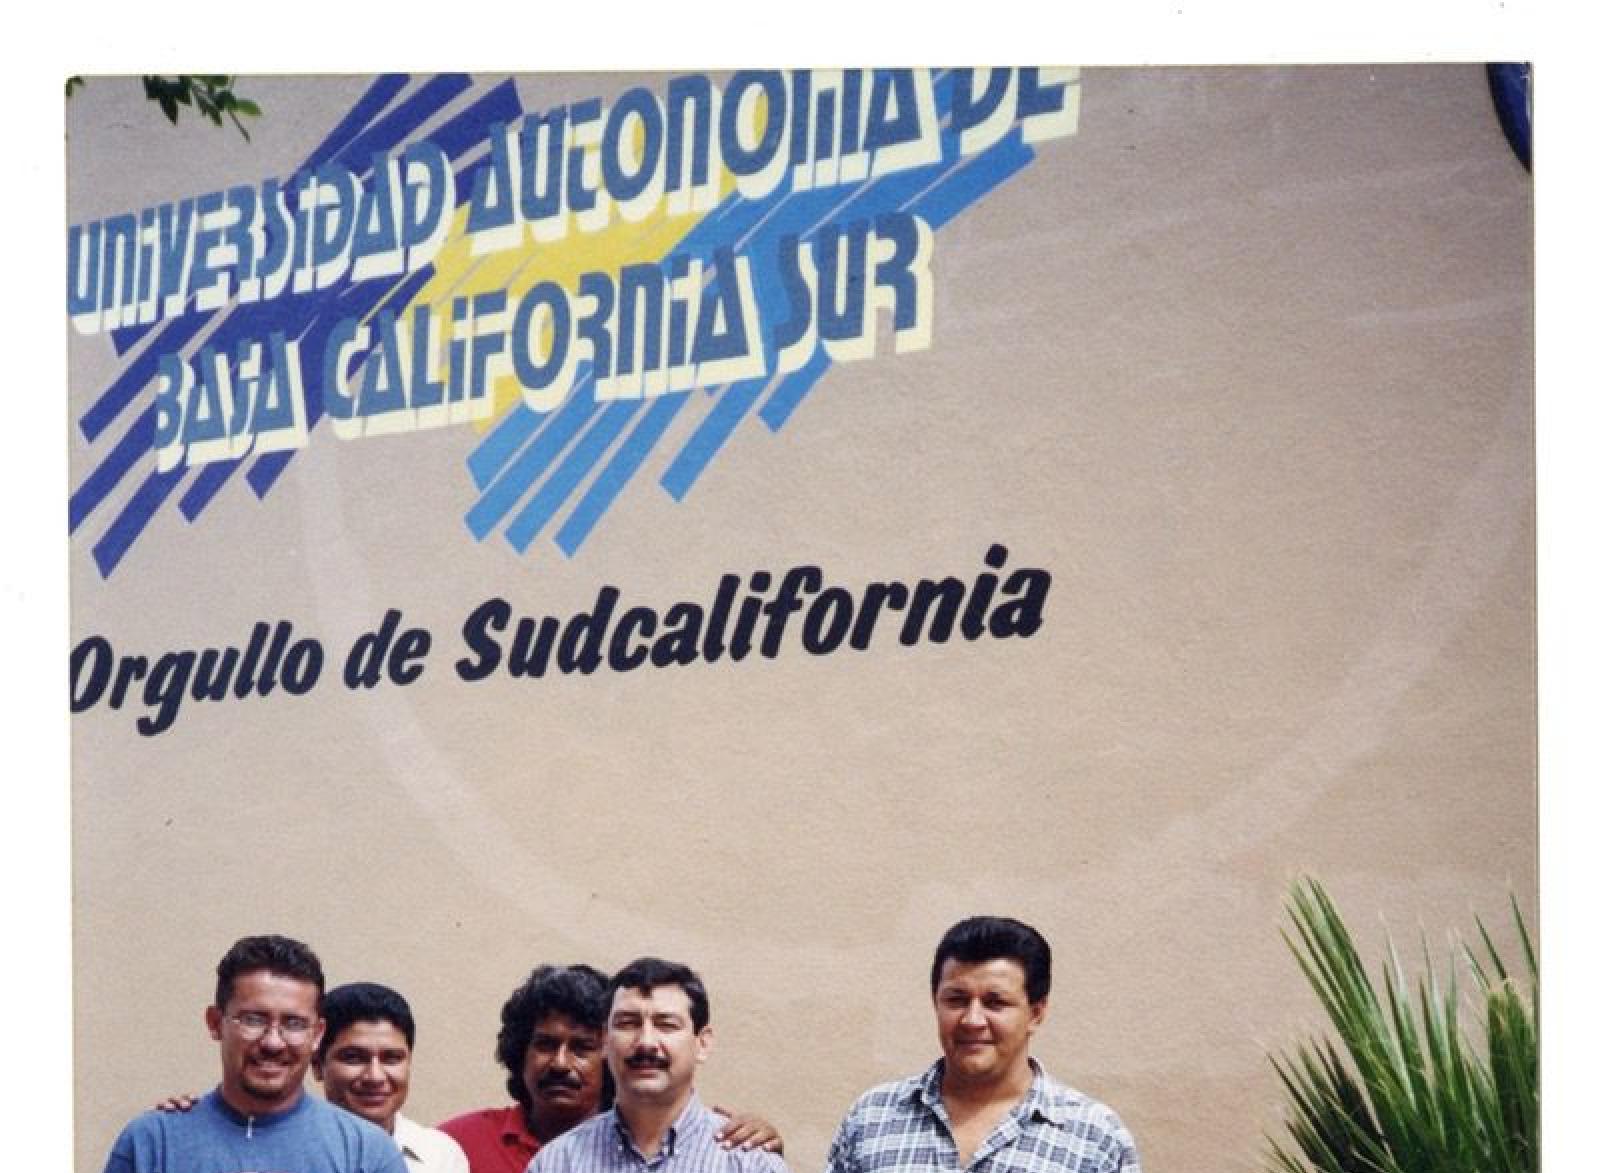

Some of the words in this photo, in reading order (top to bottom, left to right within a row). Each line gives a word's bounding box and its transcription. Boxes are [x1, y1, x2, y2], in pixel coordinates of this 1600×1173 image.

[68, 142, 457, 334] UNIVERSIDAD
[154, 331, 308, 474] BAJA
[322, 244, 766, 440] CALIFORNIA
[774, 211, 935, 373] SUR
[69, 619, 324, 736] Orgullo
[343, 608, 432, 690] de
[455, 543, 1052, 682] Sudcalifornia
